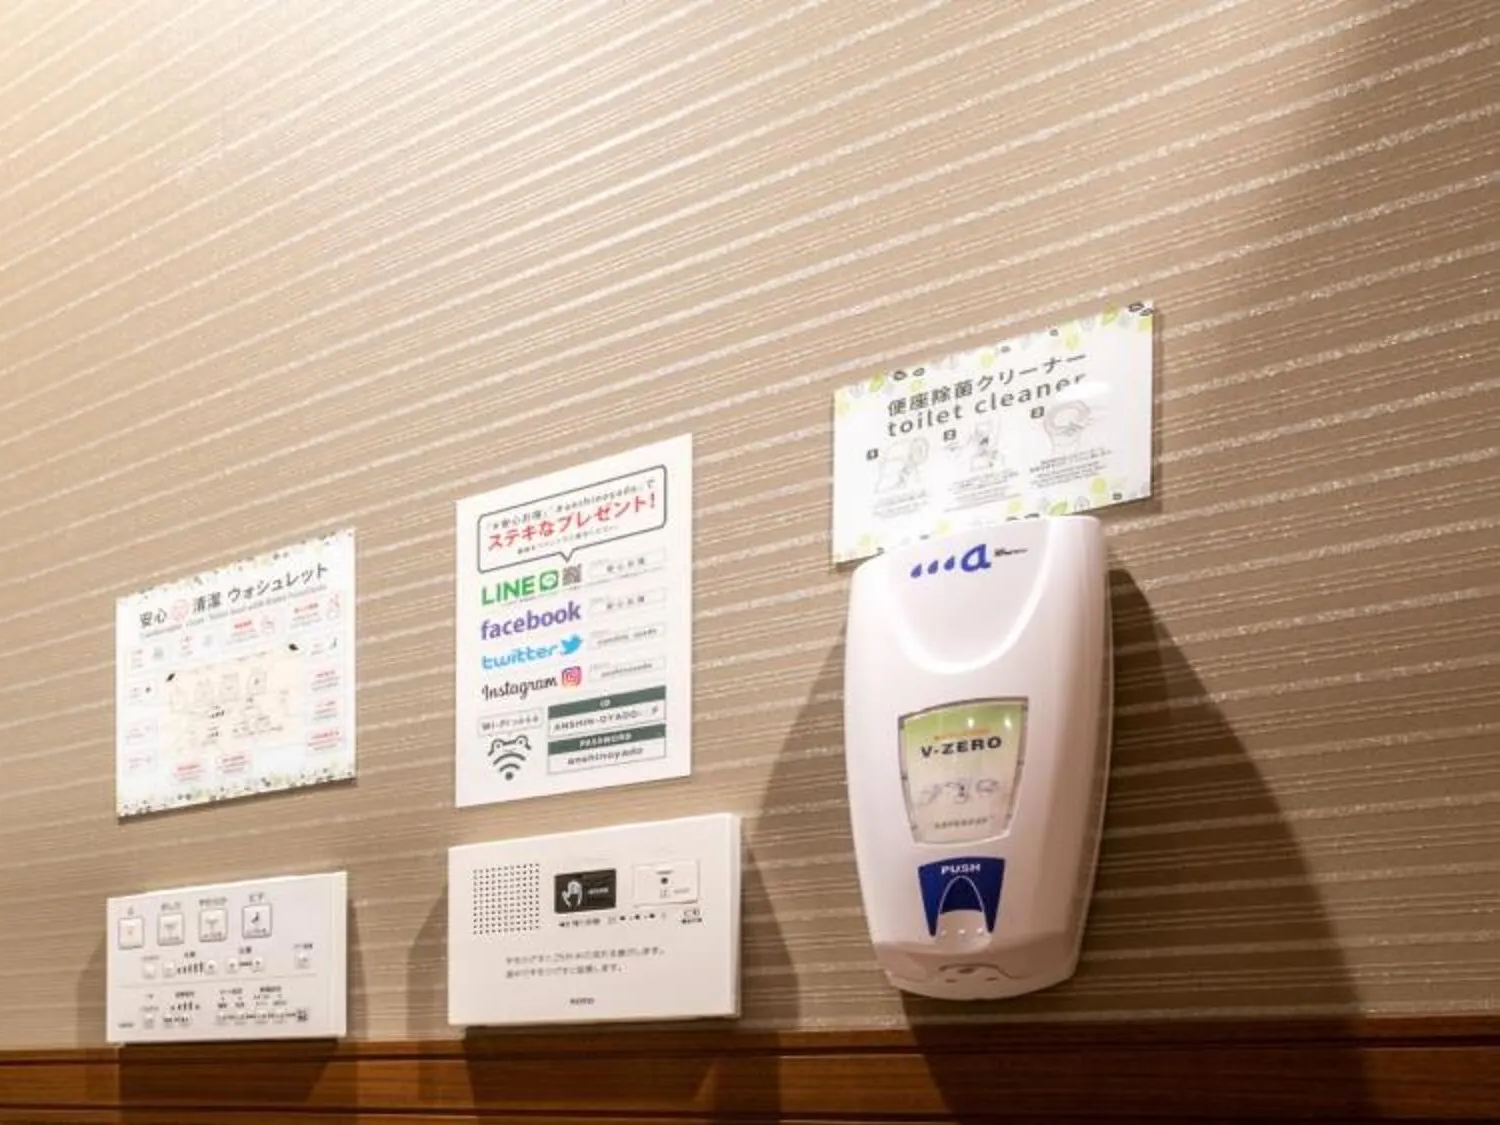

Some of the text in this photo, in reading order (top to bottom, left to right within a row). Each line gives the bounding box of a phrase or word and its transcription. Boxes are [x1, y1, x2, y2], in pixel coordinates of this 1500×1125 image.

[887, 354, 1086, 417] 便座除菌クリーナー
[887, 373, 1086, 437] toilet cleaner
[227, 562, 329, 603] ウォシュレット
[482, 575, 536, 606] LINE
[482, 600, 581, 640] facebook
[482, 644, 559, 669] twitter
[482, 676, 559, 701] Instagram
[921, 736, 1003, 758] V-ZERO
[940, 863, 982, 875] PUSH
